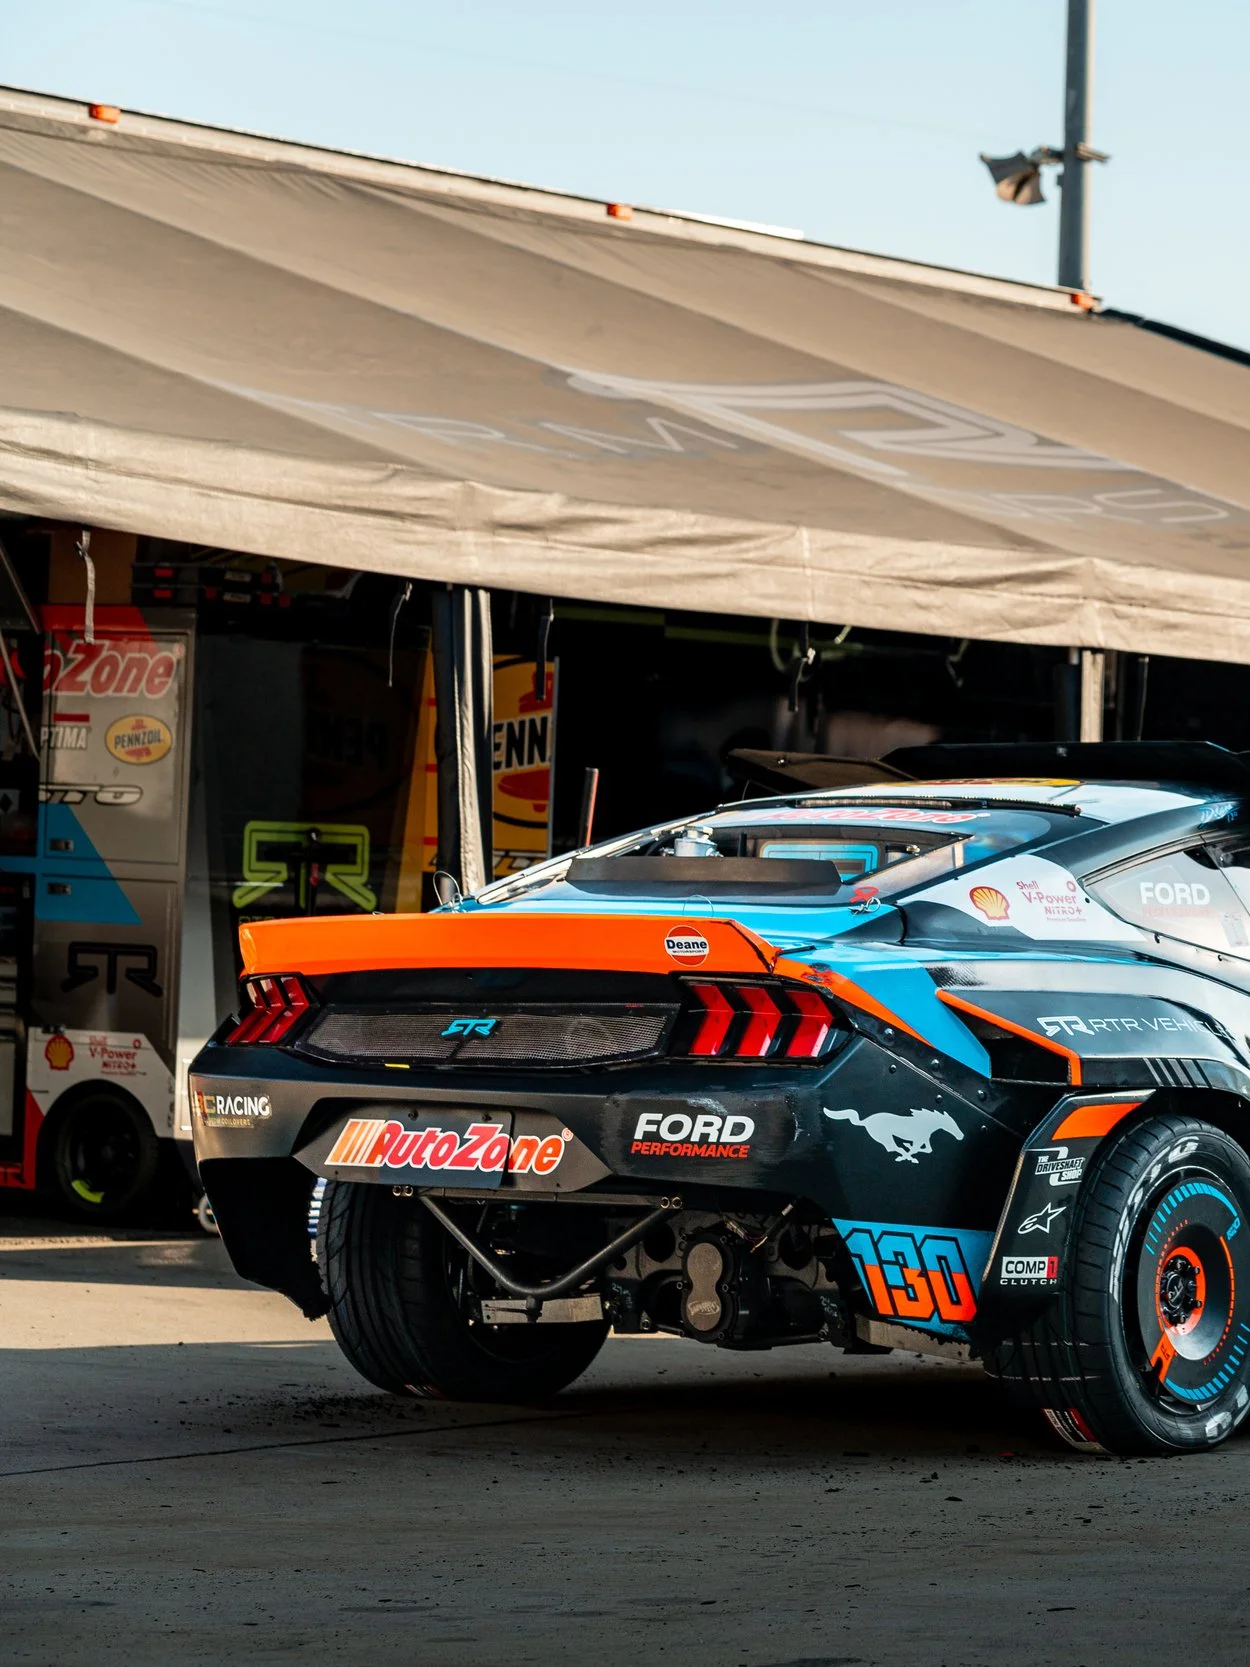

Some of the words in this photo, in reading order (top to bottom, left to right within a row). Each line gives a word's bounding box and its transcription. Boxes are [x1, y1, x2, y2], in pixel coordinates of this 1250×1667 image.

[114, 731, 162, 749] PENNZOIL
[1017, 881, 1040, 890] Shell
[1022, 891, 1077, 904] V-Power
[1140, 882, 1210, 905] FORD
[666, 939, 707, 949] Deane
[1089, 1018, 1143, 1032] RTR
[89, 1047, 138, 1060] V-Power
[634, 1112, 755, 1143] FORD
[366, 1119, 566, 1175] AutoZone
[630, 1141, 751, 1159] PERFORMANCE
[1036, 1157, 1084, 1174] DRIVESHAFT
[1038, 1155, 1049, 1163] THE
[1060, 1169, 1083, 1181] SHOP
[843, 1228, 978, 1324] 130
[1000, 1278, 1057, 1286] CLUTCH
